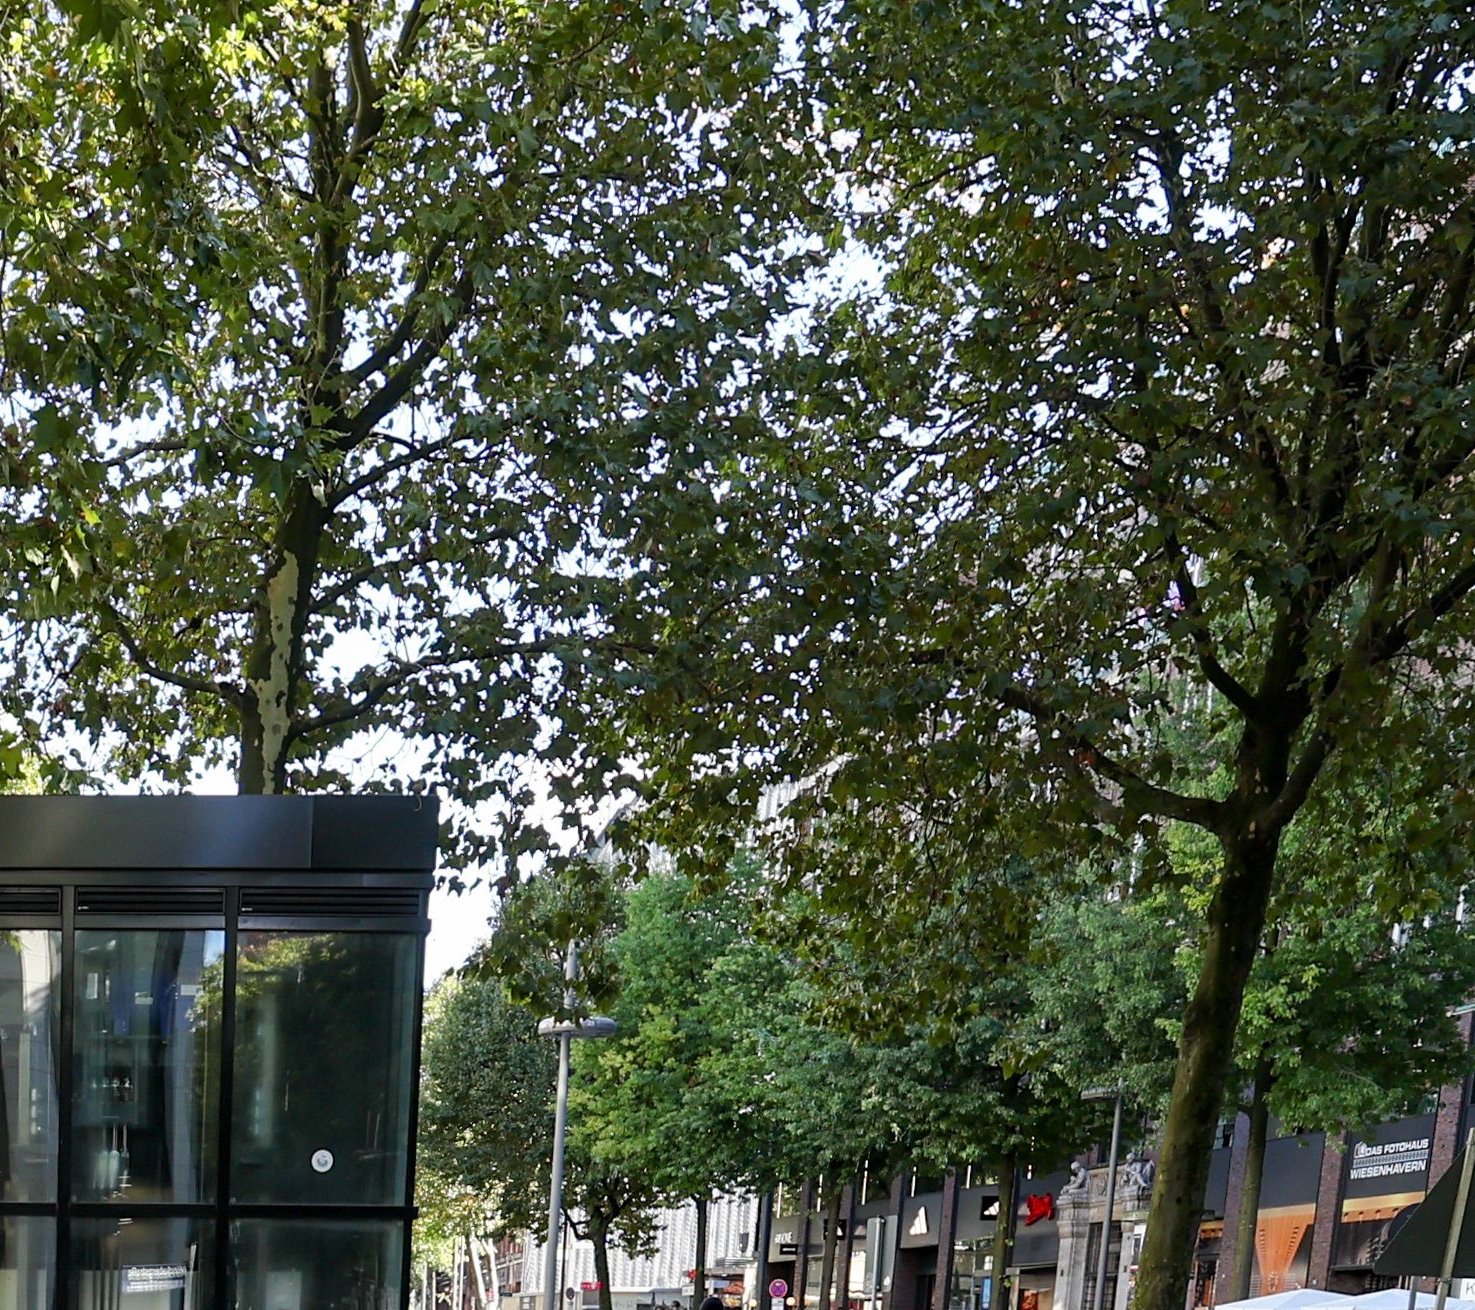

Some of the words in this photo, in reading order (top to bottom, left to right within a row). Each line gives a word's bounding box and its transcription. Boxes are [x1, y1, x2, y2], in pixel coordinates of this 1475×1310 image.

[1365, 1145, 1383, 1156] DAS
[1384, 1139, 1430, 1154] FOTOHAUS
[1350, 1159, 1427, 1180] WIESENHAVERN
